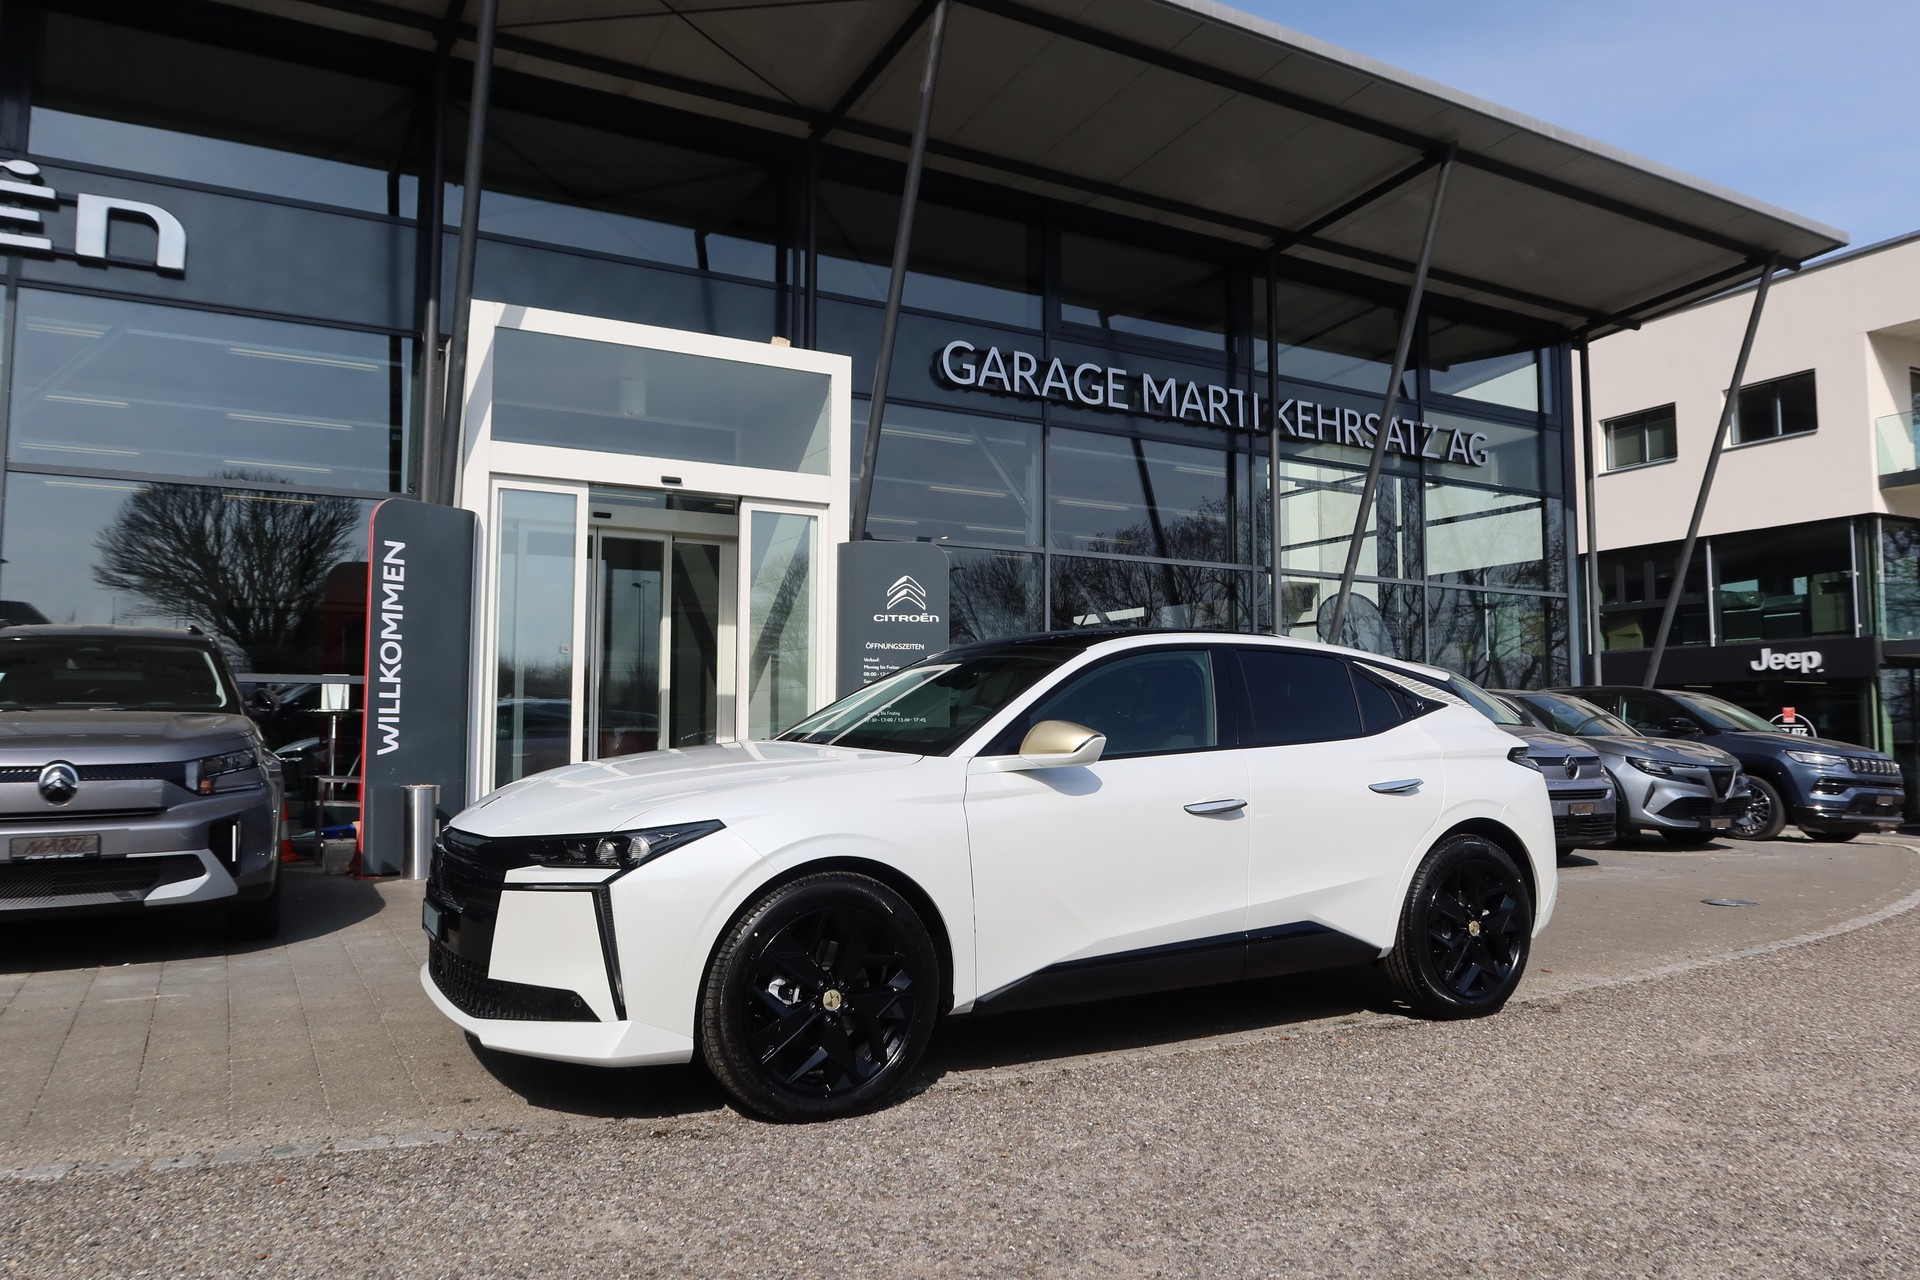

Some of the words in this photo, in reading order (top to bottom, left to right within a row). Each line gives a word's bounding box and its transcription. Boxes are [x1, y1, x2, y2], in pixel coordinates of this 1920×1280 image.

[943, 340, 1129, 410] GARAGE
[1143, 373, 1260, 431] MARTI
[1278, 398, 1440, 459] KEHRSATZ
[1448, 428, 1488, 467] AG
[376, 540, 406, 756] WILLKOMMEN
[865, 641, 925, 650] ÖFFNUNGSZEITEN
[1750, 648, 1823, 674] Jeep
